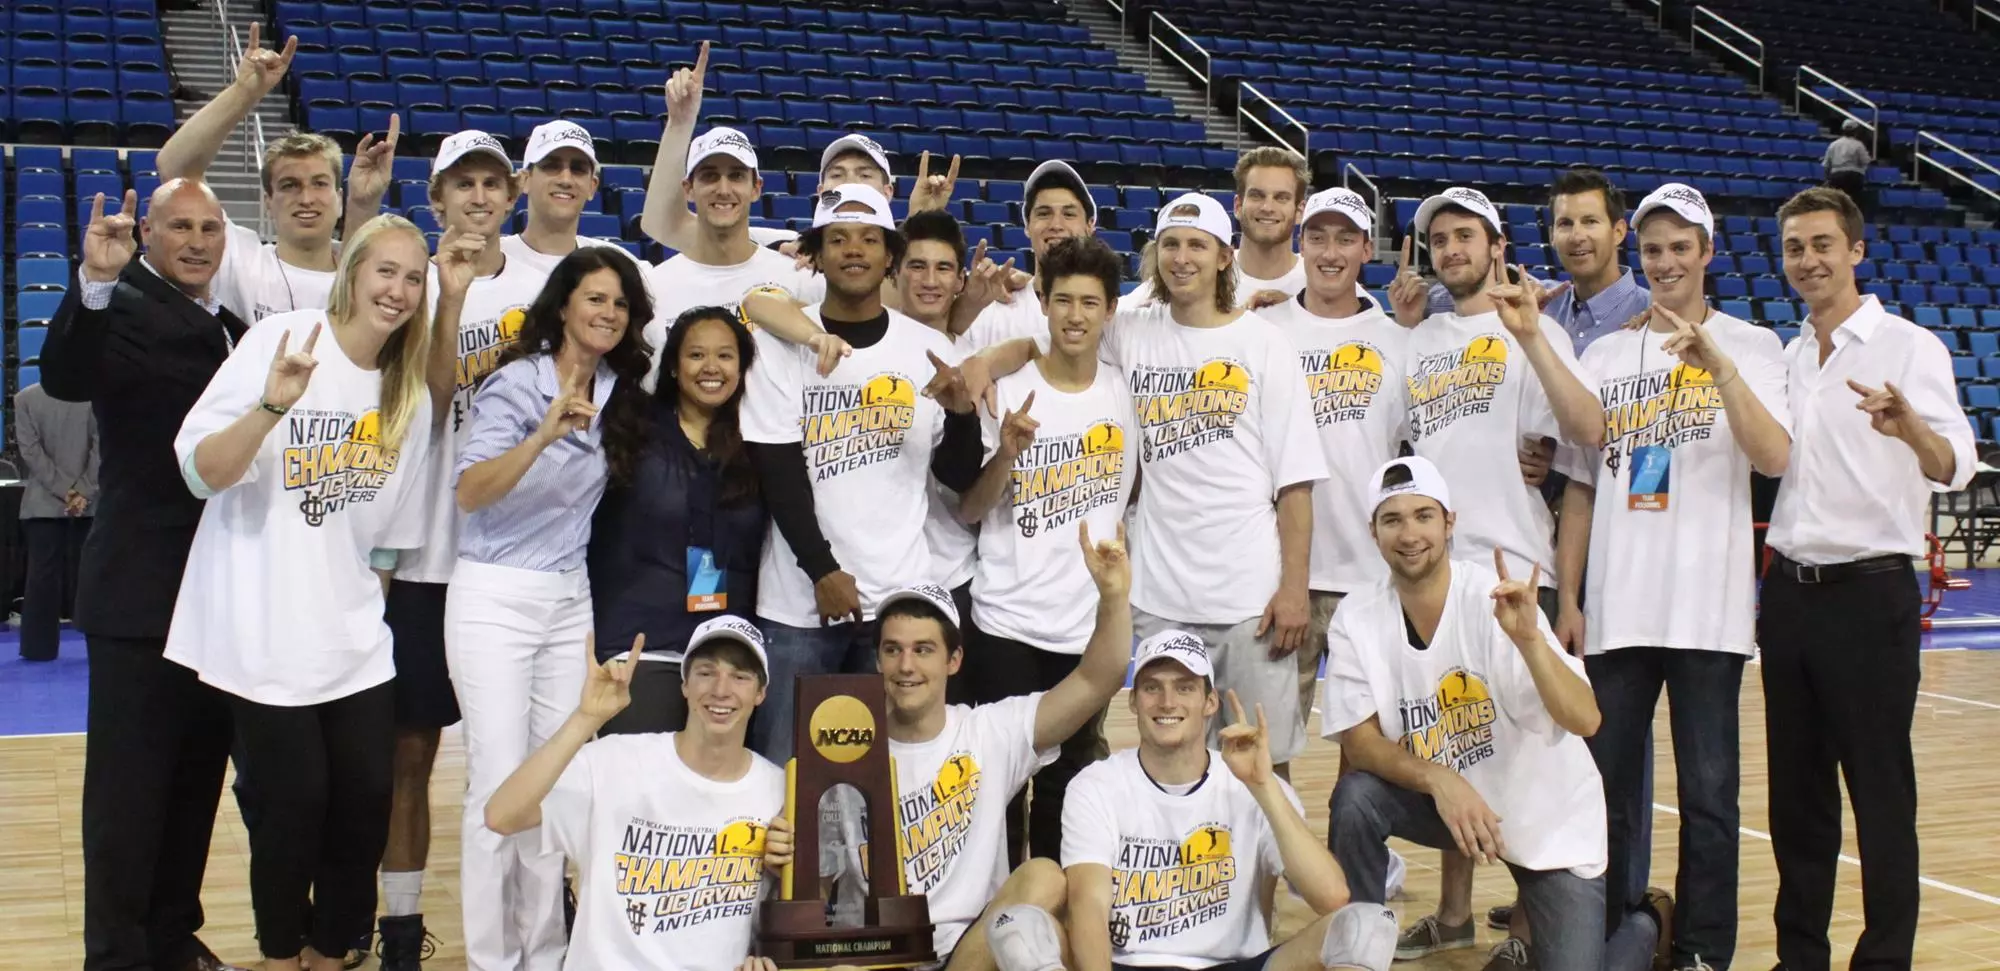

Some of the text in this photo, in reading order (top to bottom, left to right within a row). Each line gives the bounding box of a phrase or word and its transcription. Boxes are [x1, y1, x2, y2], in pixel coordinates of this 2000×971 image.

[460, 321, 512, 354] IONAL
[1130, 370, 1206, 393] NATIONAL
[1306, 370, 1382, 399] PIONS
[803, 387, 875, 414] TIONAL
[1133, 390, 1248, 428] HAMPIONS
[1314, 393, 1371, 416] IRVINE
[1424, 385, 1495, 424] UC IRVINE
[802, 405, 915, 449] AMPIONS
[1155, 414, 1236, 446] UC IRVINE
[1316, 409, 1366, 429] EATERS
[1602, 386, 1725, 450] HAMPIONS
[815, 430, 904, 468] UC IRVINE
[1156, 430, 1234, 462] ANTEATERS
[816, 447, 900, 483] ANTEATERS
[1042, 491, 1071, 517] UC
[817, 727, 874, 748] NCAA
[900, 781, 950, 826] IONAL
[622, 825, 730, 857] NATIONAL
[1119, 843, 1195, 869] ATIONAL
[914, 845, 941, 881] UC
[653, 884, 758, 917] UC IRVINE
[1136, 884, 1230, 928] UC IRVINE
[653, 902, 752, 934] ANTEATERS
[1139, 903, 1228, 944] ANTEATERS
[815, 940, 892, 954] NATIONAL CHAMPION
